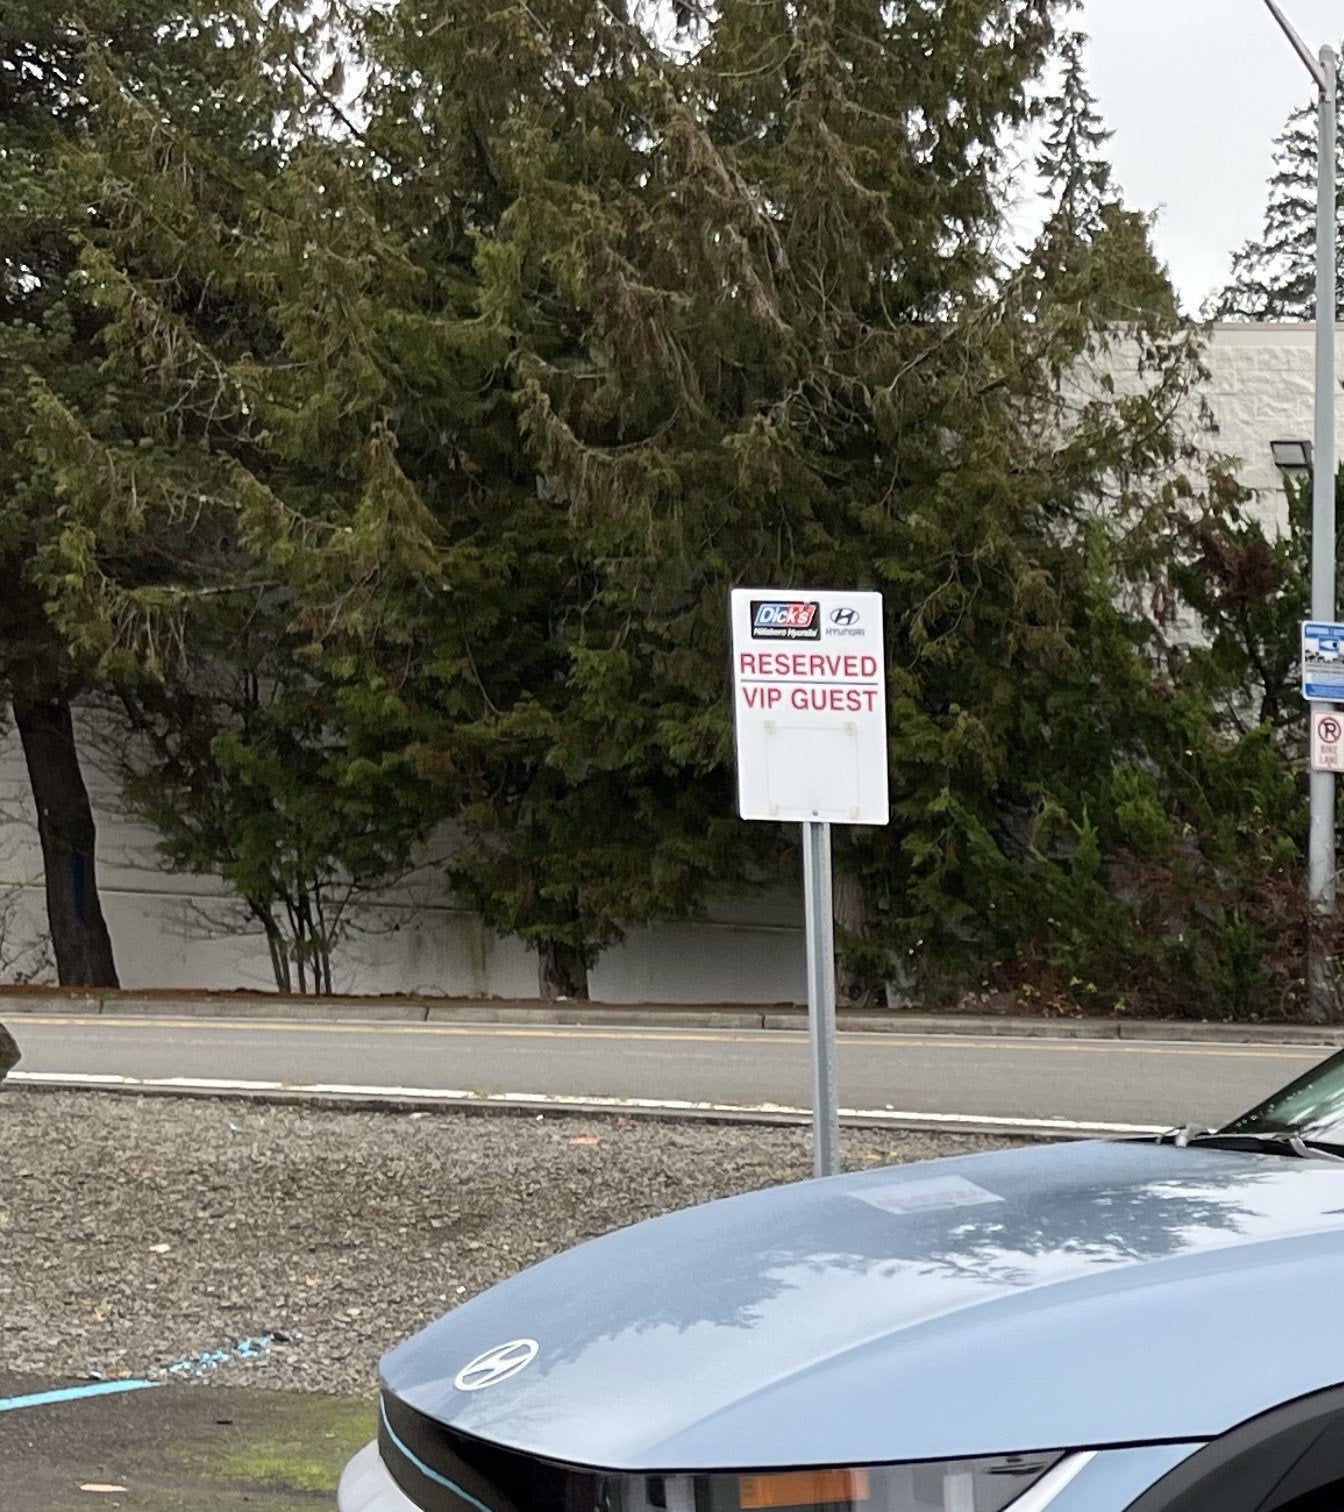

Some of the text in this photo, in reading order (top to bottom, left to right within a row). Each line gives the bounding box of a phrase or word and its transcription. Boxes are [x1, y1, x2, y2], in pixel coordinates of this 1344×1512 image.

[740, 653, 878, 677] RESERVED
[742, 687, 878, 712] VIP GUEST
